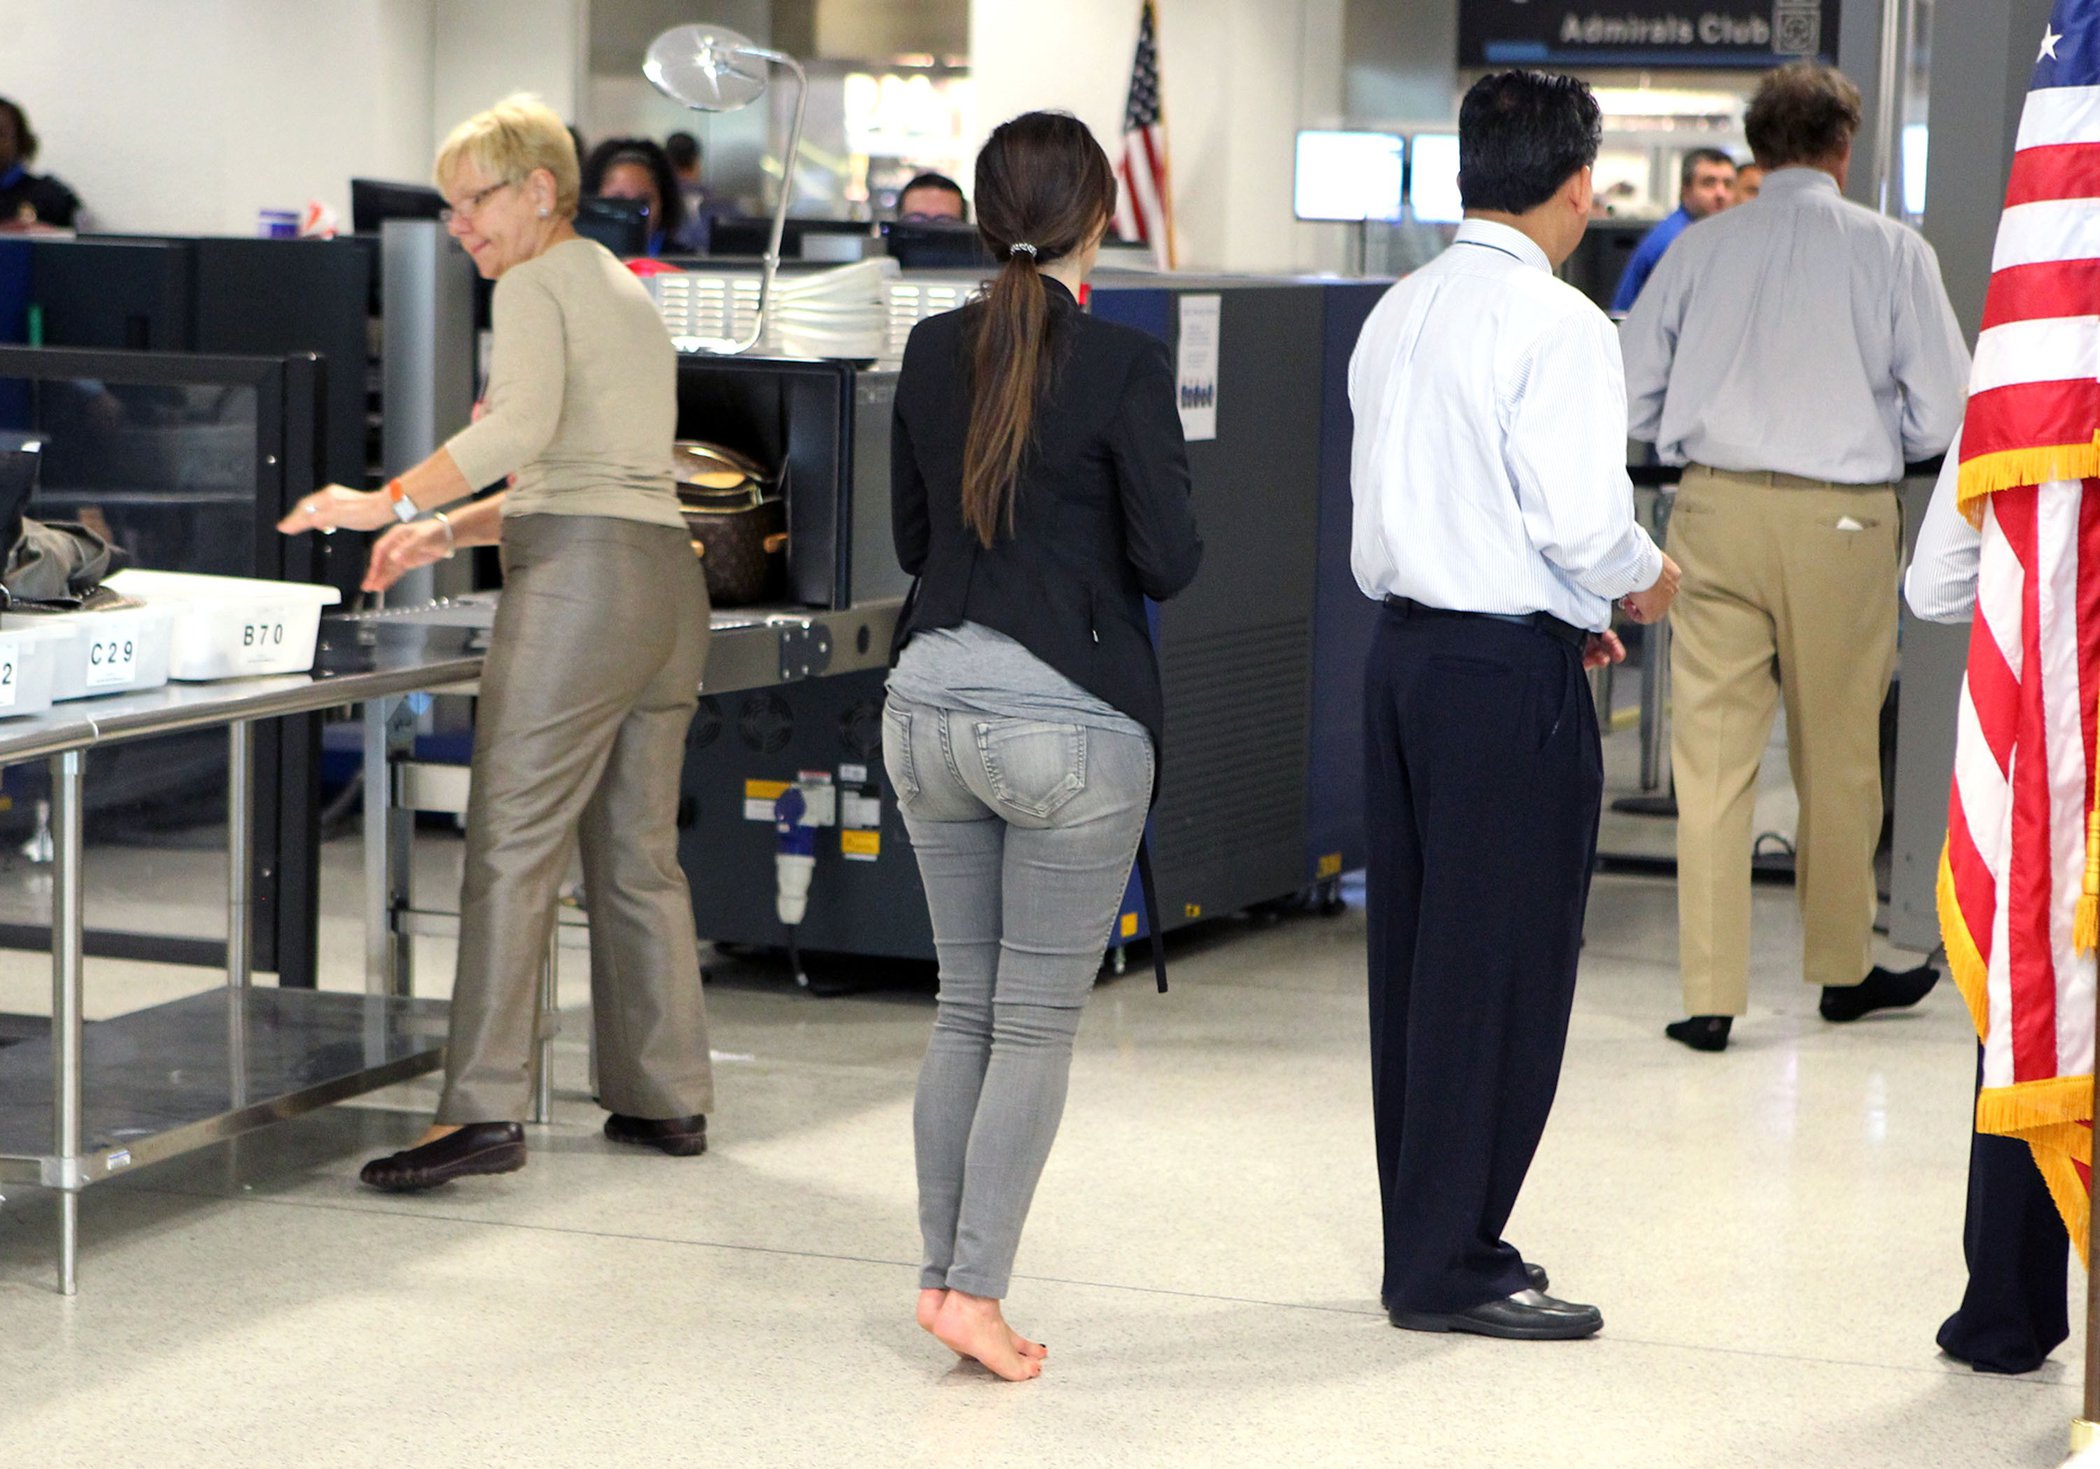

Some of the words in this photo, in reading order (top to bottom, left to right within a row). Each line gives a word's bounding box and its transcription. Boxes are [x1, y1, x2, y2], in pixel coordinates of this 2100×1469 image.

[1560, 12, 1693, 44] Admirals
[1699, 12, 1770, 44] Club
[243, 623, 283, 647] B70
[91, 640, 133, 666] C29
